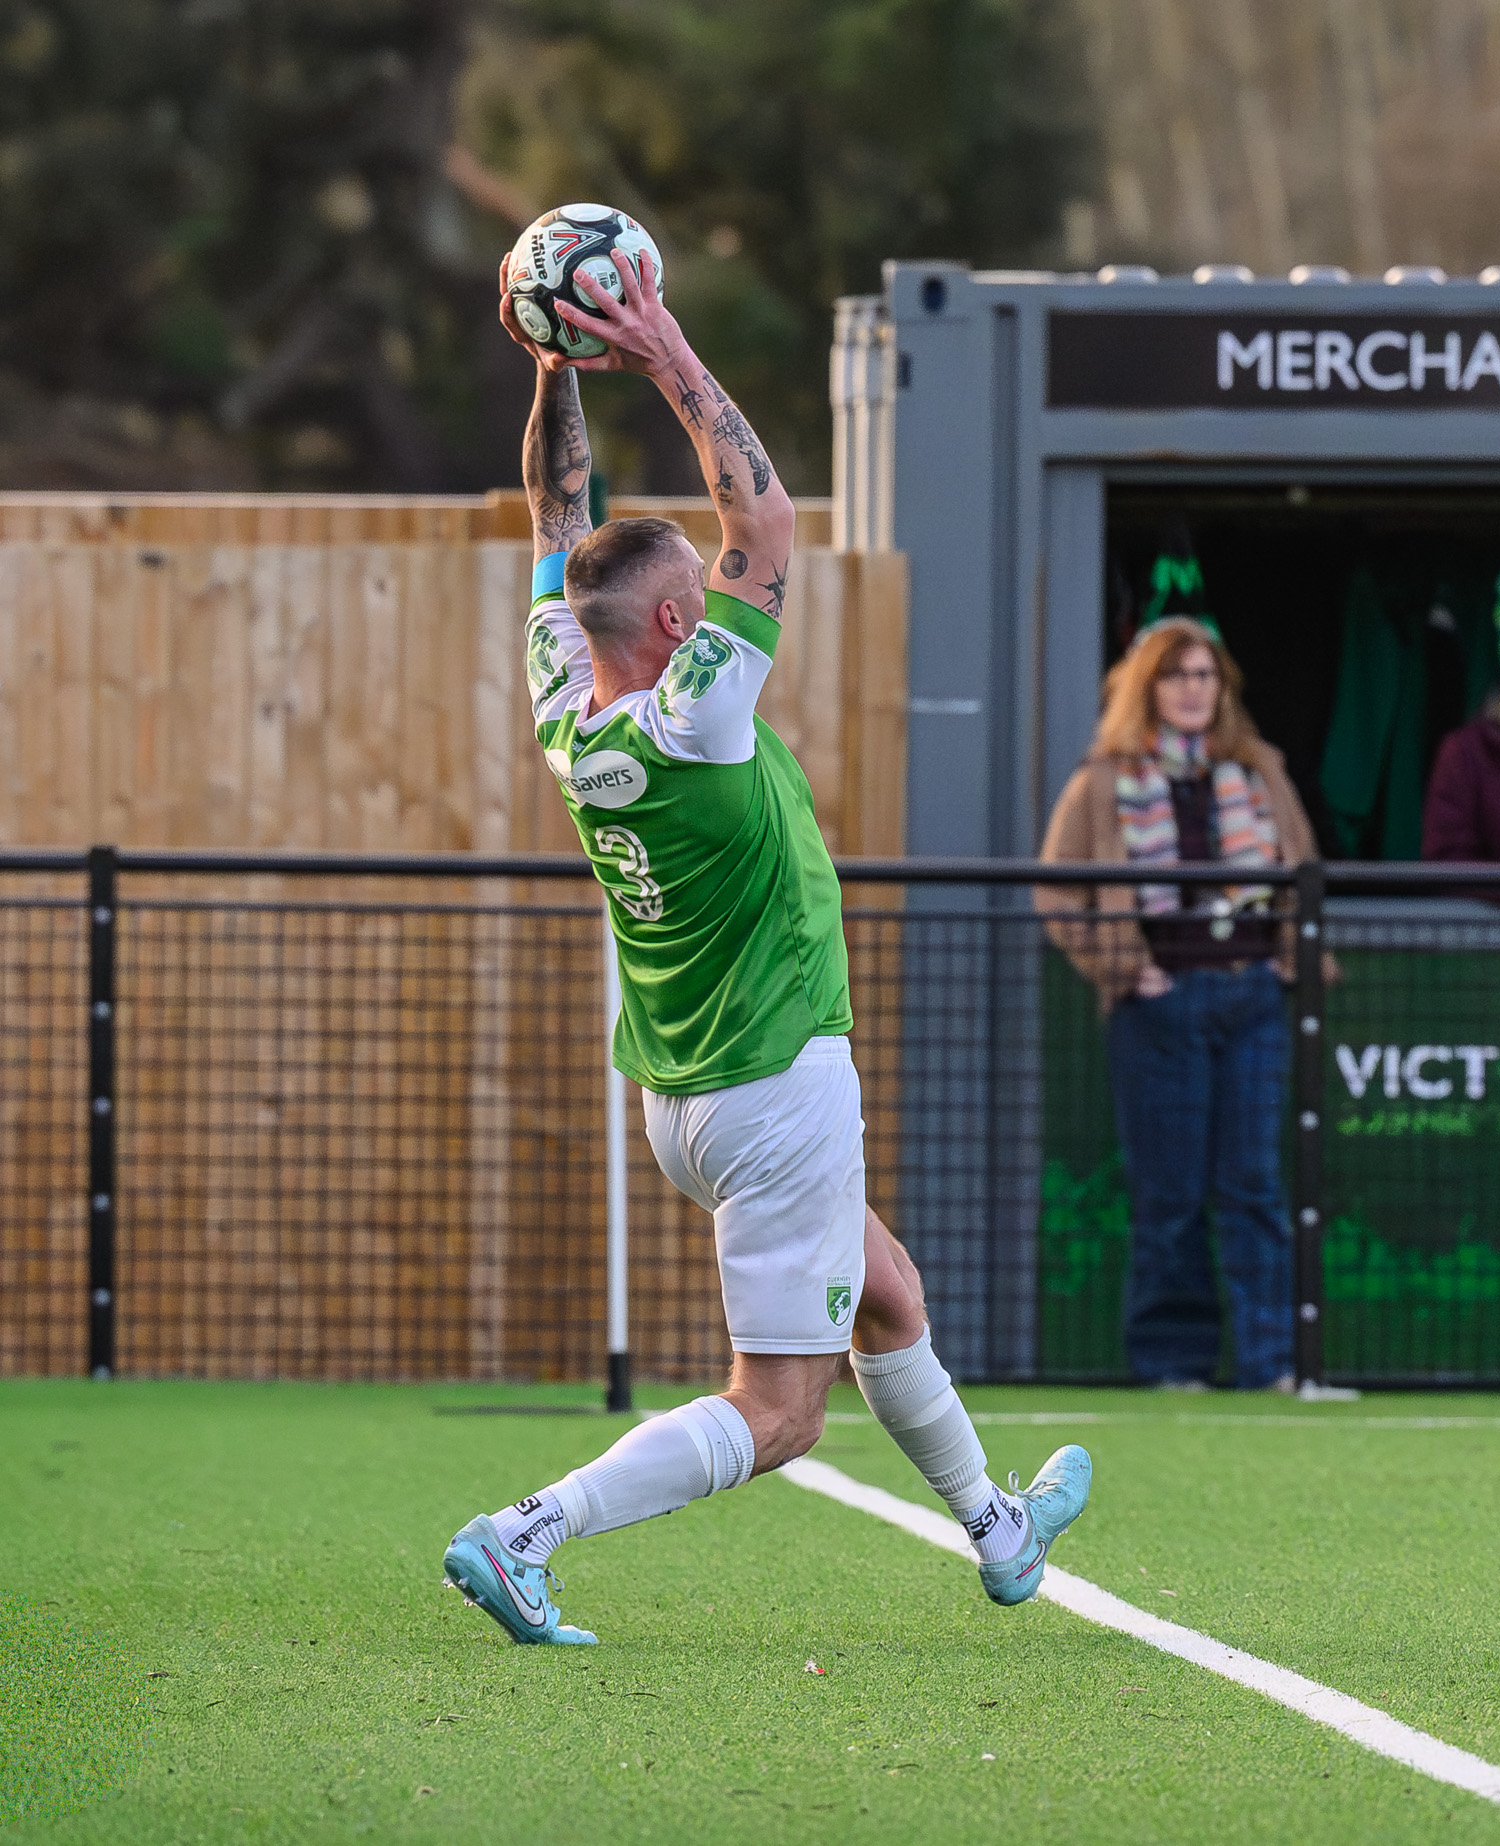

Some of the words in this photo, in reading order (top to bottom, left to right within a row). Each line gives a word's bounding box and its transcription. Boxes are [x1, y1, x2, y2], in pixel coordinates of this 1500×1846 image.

[560, 768, 634, 792] savers
[595, 825, 663, 921] 3
[965, 1505, 996, 1538] FS
[510, 1534, 531, 1552] FS
